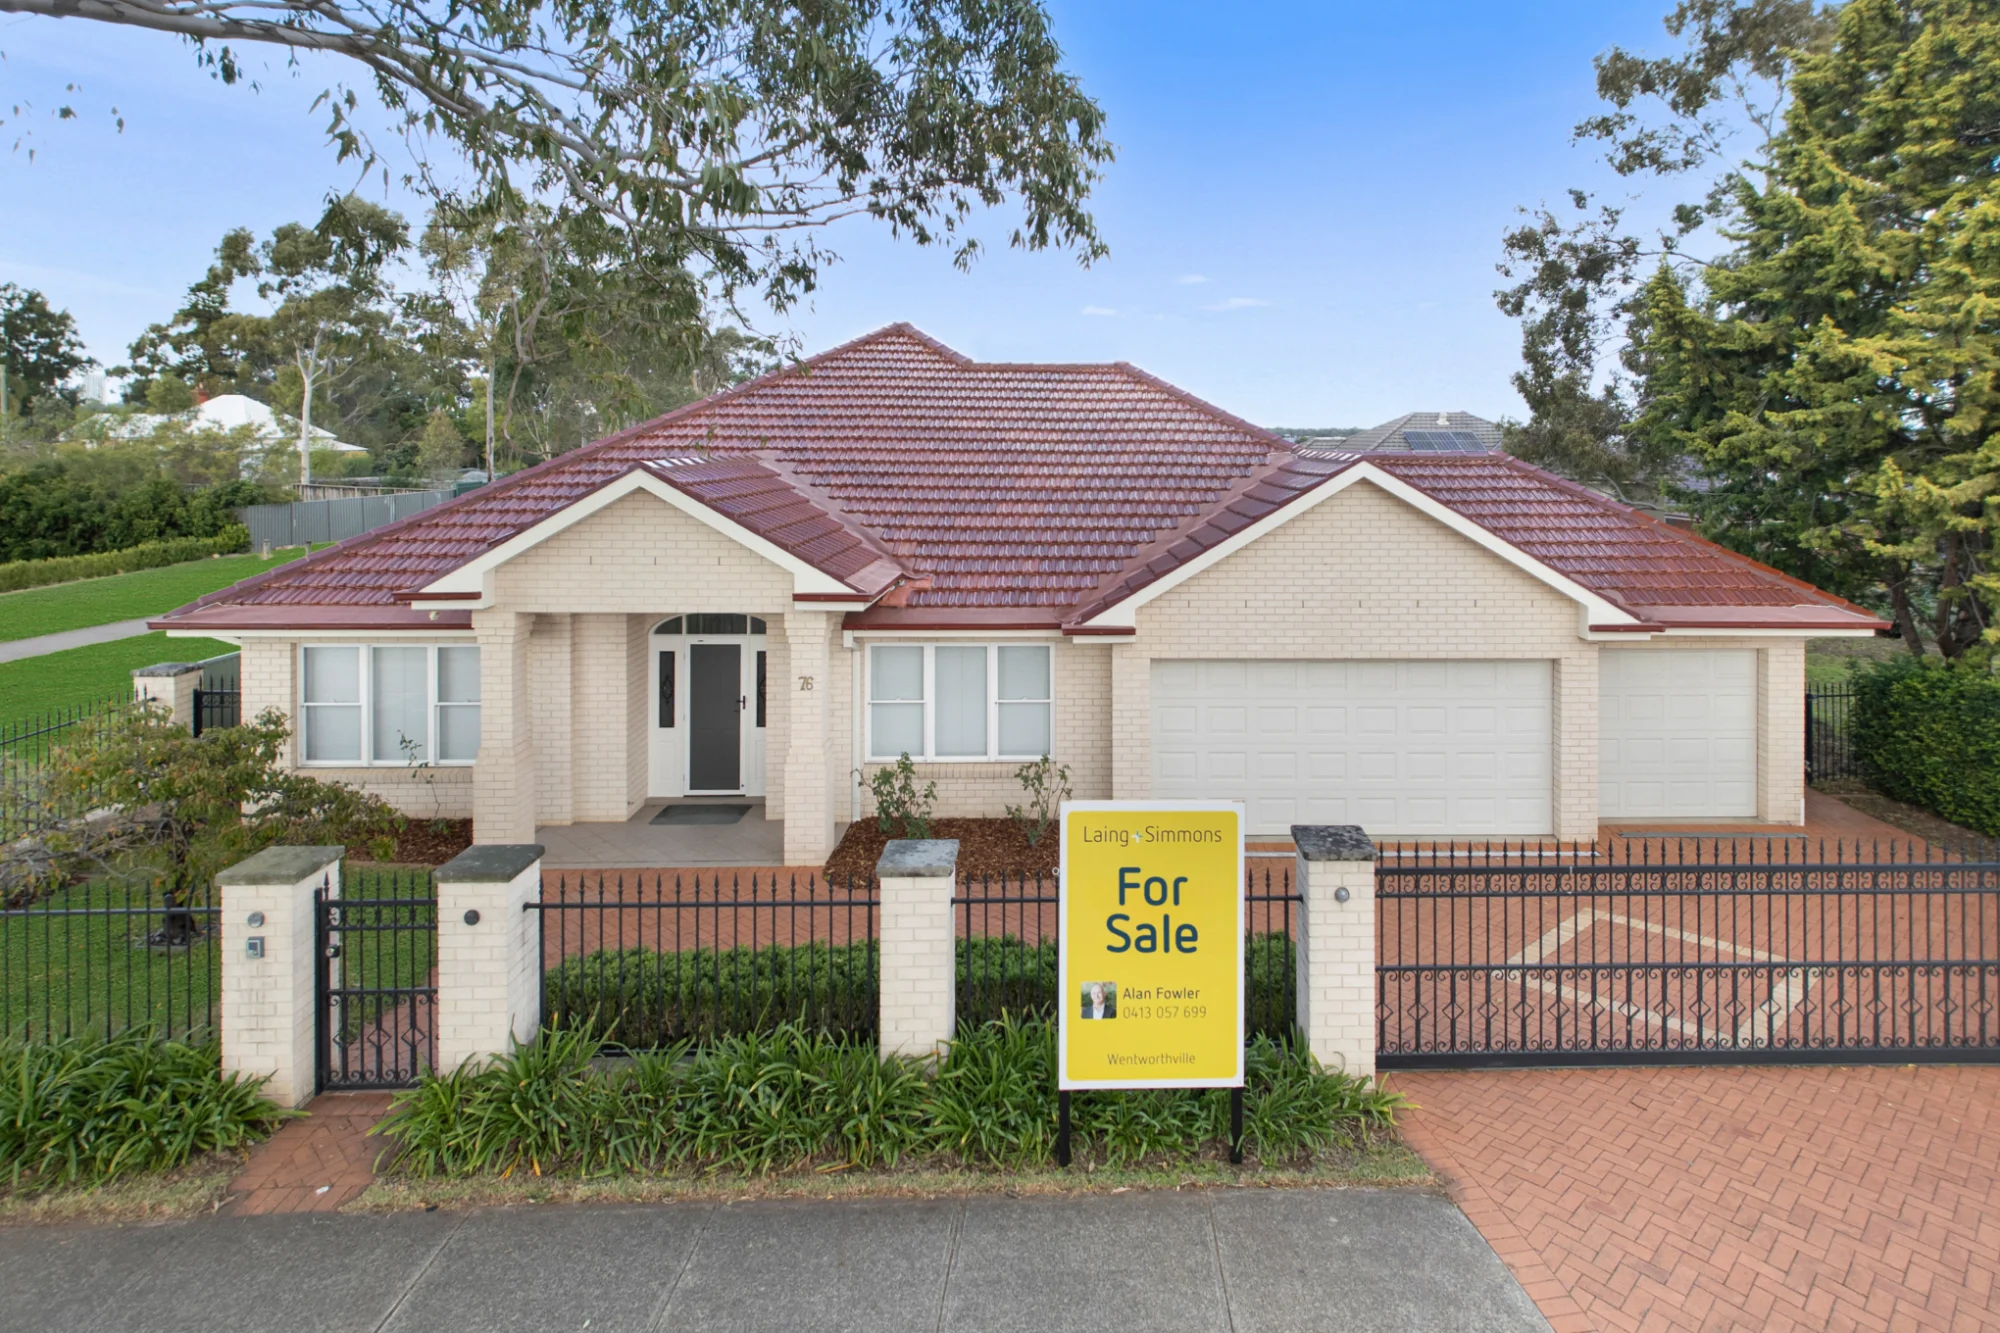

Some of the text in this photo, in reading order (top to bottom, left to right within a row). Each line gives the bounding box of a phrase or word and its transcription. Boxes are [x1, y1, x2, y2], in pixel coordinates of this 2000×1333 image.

[798, 676, 814, 691] 76
[1118, 867, 1188, 906] For
[1106, 913, 1198, 953] Sale
[1122, 987, 1200, 1000] Alan Fowler
[1123, 1006, 1207, 1019] 0413 057 699
[1107, 1053, 1196, 1066] Wentworthville
